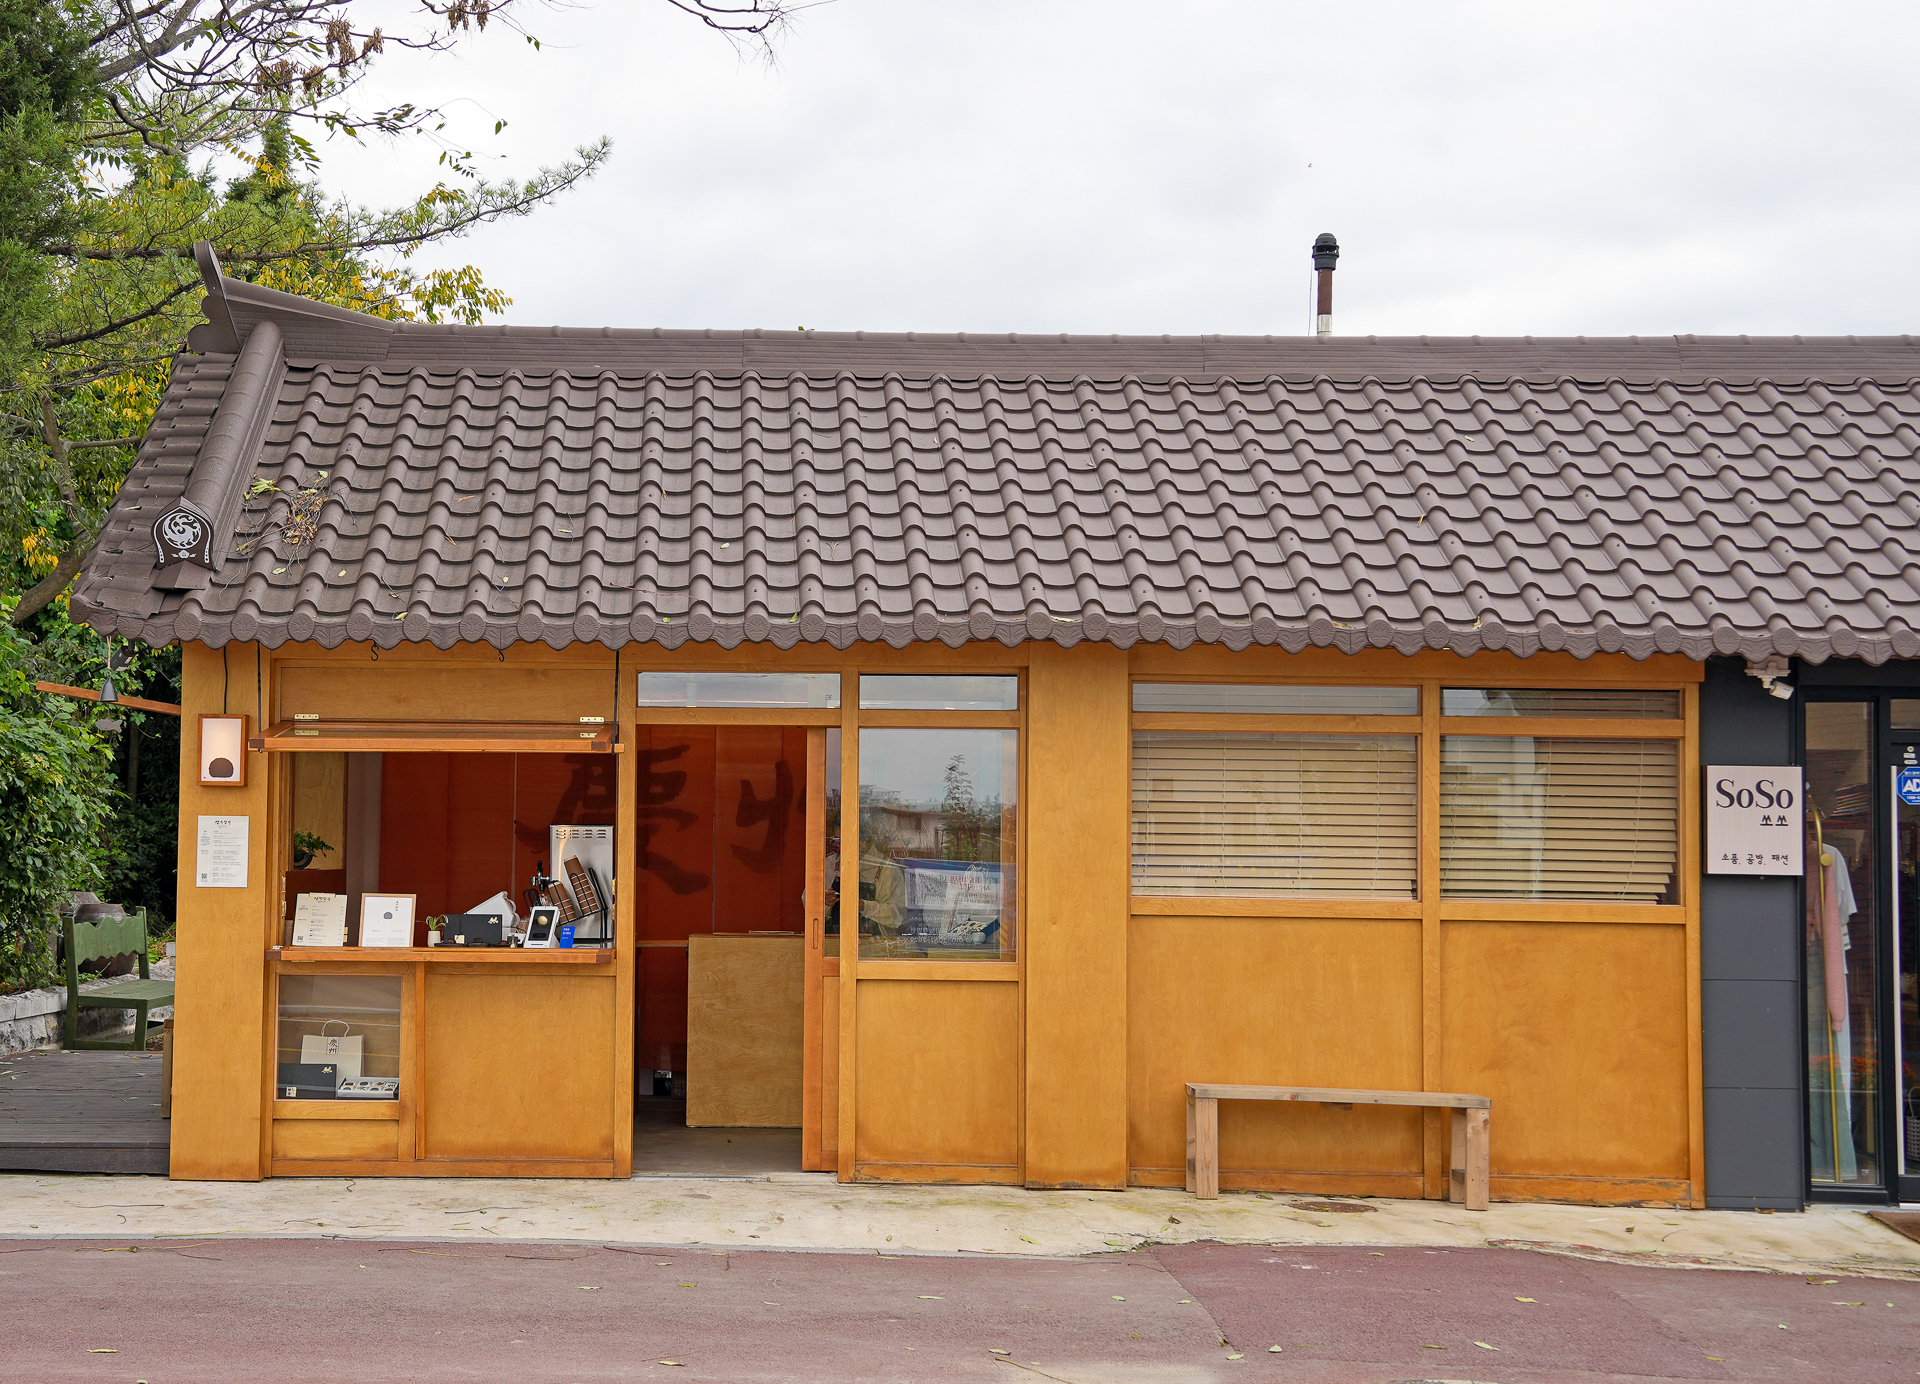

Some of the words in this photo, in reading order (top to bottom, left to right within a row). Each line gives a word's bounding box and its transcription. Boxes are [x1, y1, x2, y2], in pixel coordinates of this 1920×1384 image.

[1715, 778, 1794, 809] SoSo
[1759, 814, 1789, 827] 쏘쏘
[1771, 854, 1788, 866] 패션
